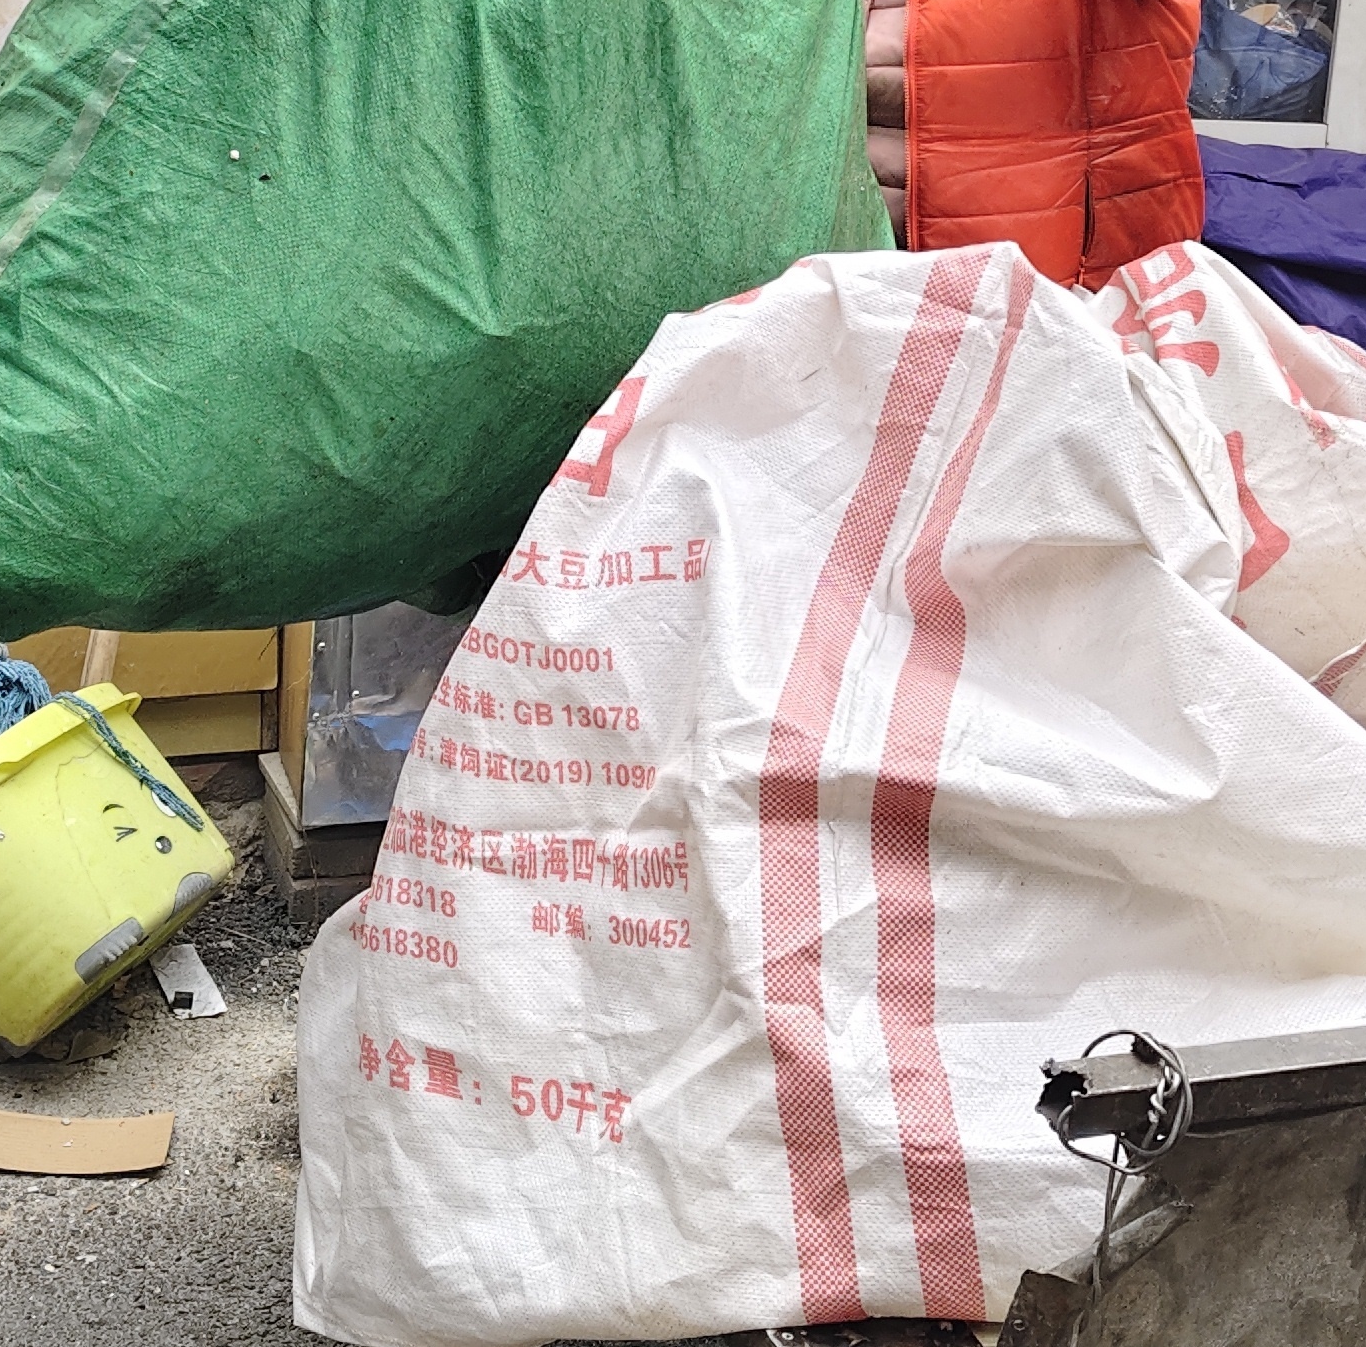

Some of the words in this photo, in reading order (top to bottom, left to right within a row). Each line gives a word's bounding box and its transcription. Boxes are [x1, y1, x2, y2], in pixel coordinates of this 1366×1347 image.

[502, 539, 712, 590] 大豆加工品
[562, 704, 640, 732] 13078
[383, 806, 690, 893] 临港经济区渤海四十路1306号
